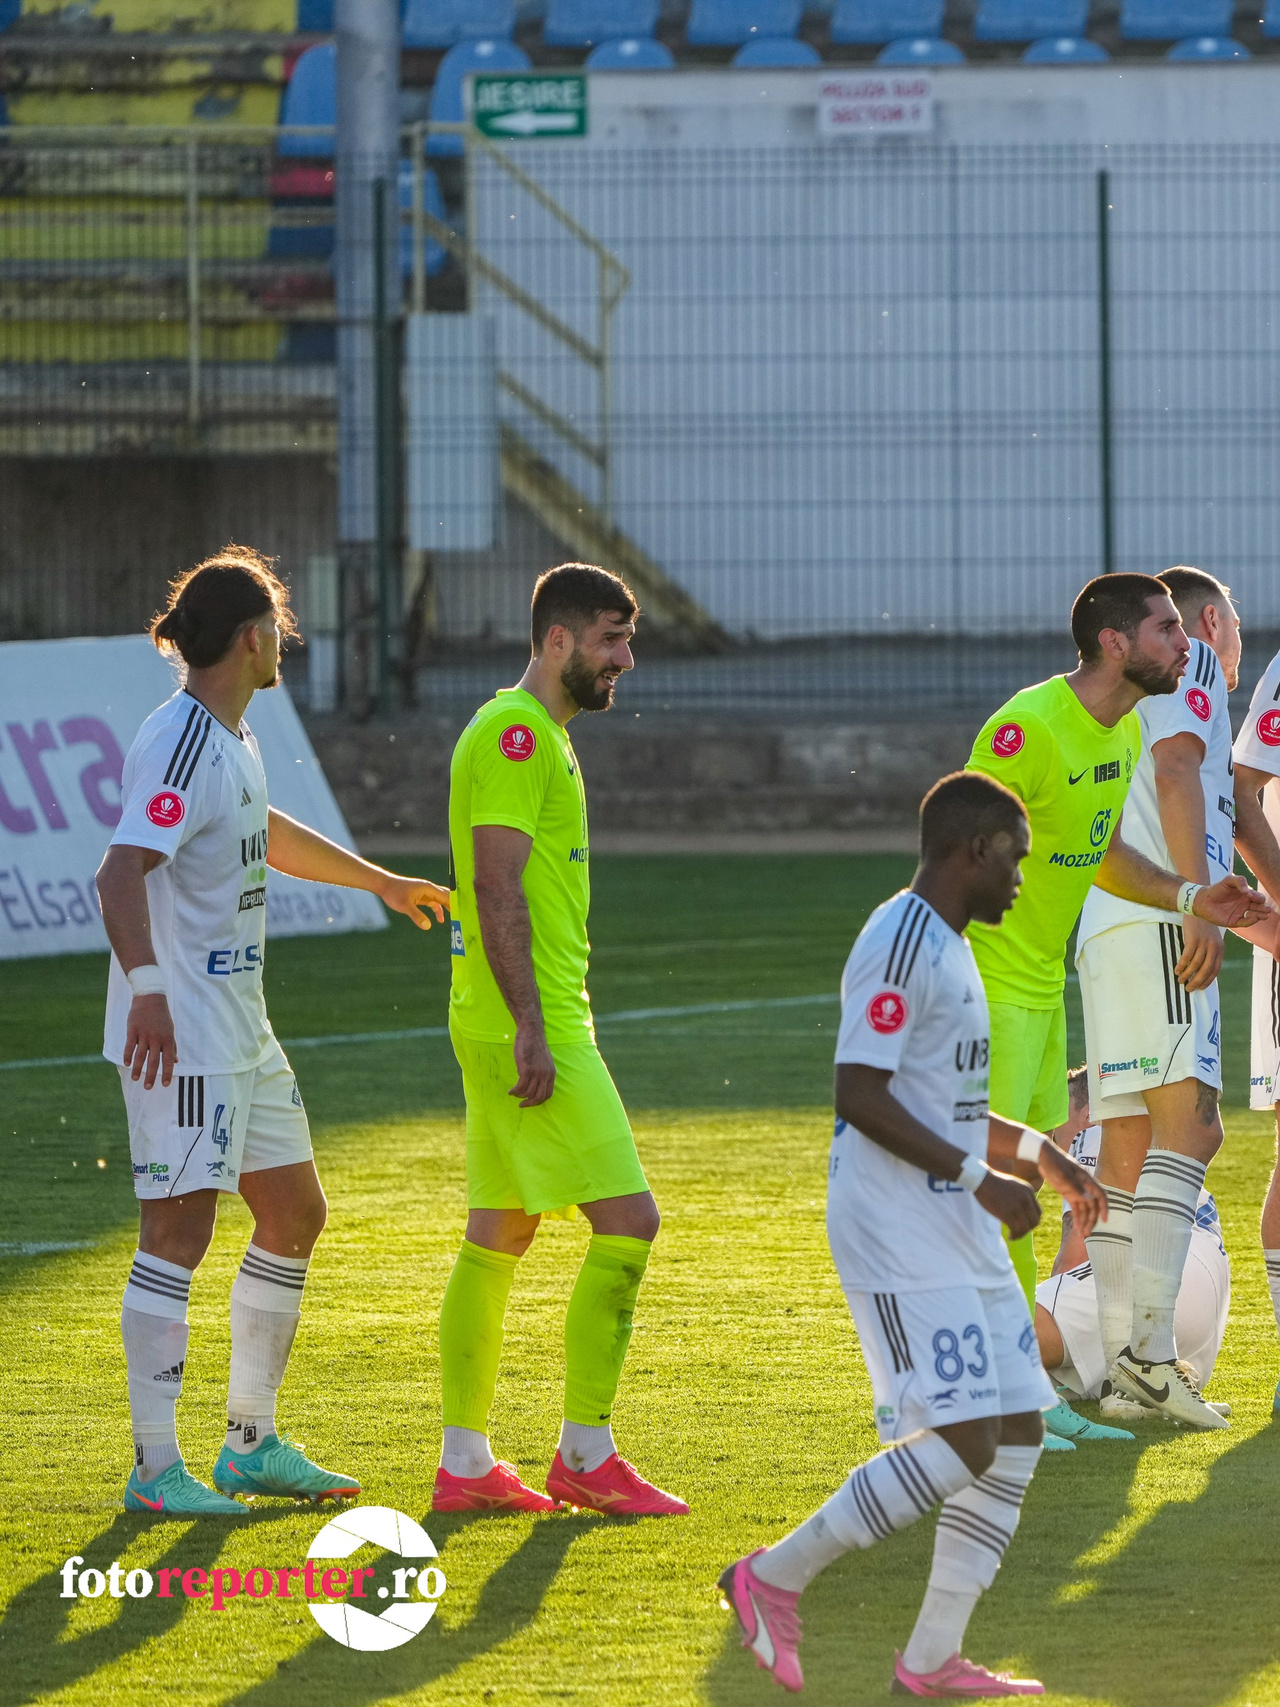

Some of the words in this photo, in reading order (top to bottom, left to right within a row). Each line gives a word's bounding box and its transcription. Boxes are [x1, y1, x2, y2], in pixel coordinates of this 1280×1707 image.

[1101, 1059, 1138, 1074] Smart
[1140, 1057, 1158, 1069] Eco
[1143, 1067, 1159, 1076] Plus
[149, 1162, 169, 1173] Eco
[152, 1174, 170, 1182] Plus
[932, 1323, 988, 1382] 83
